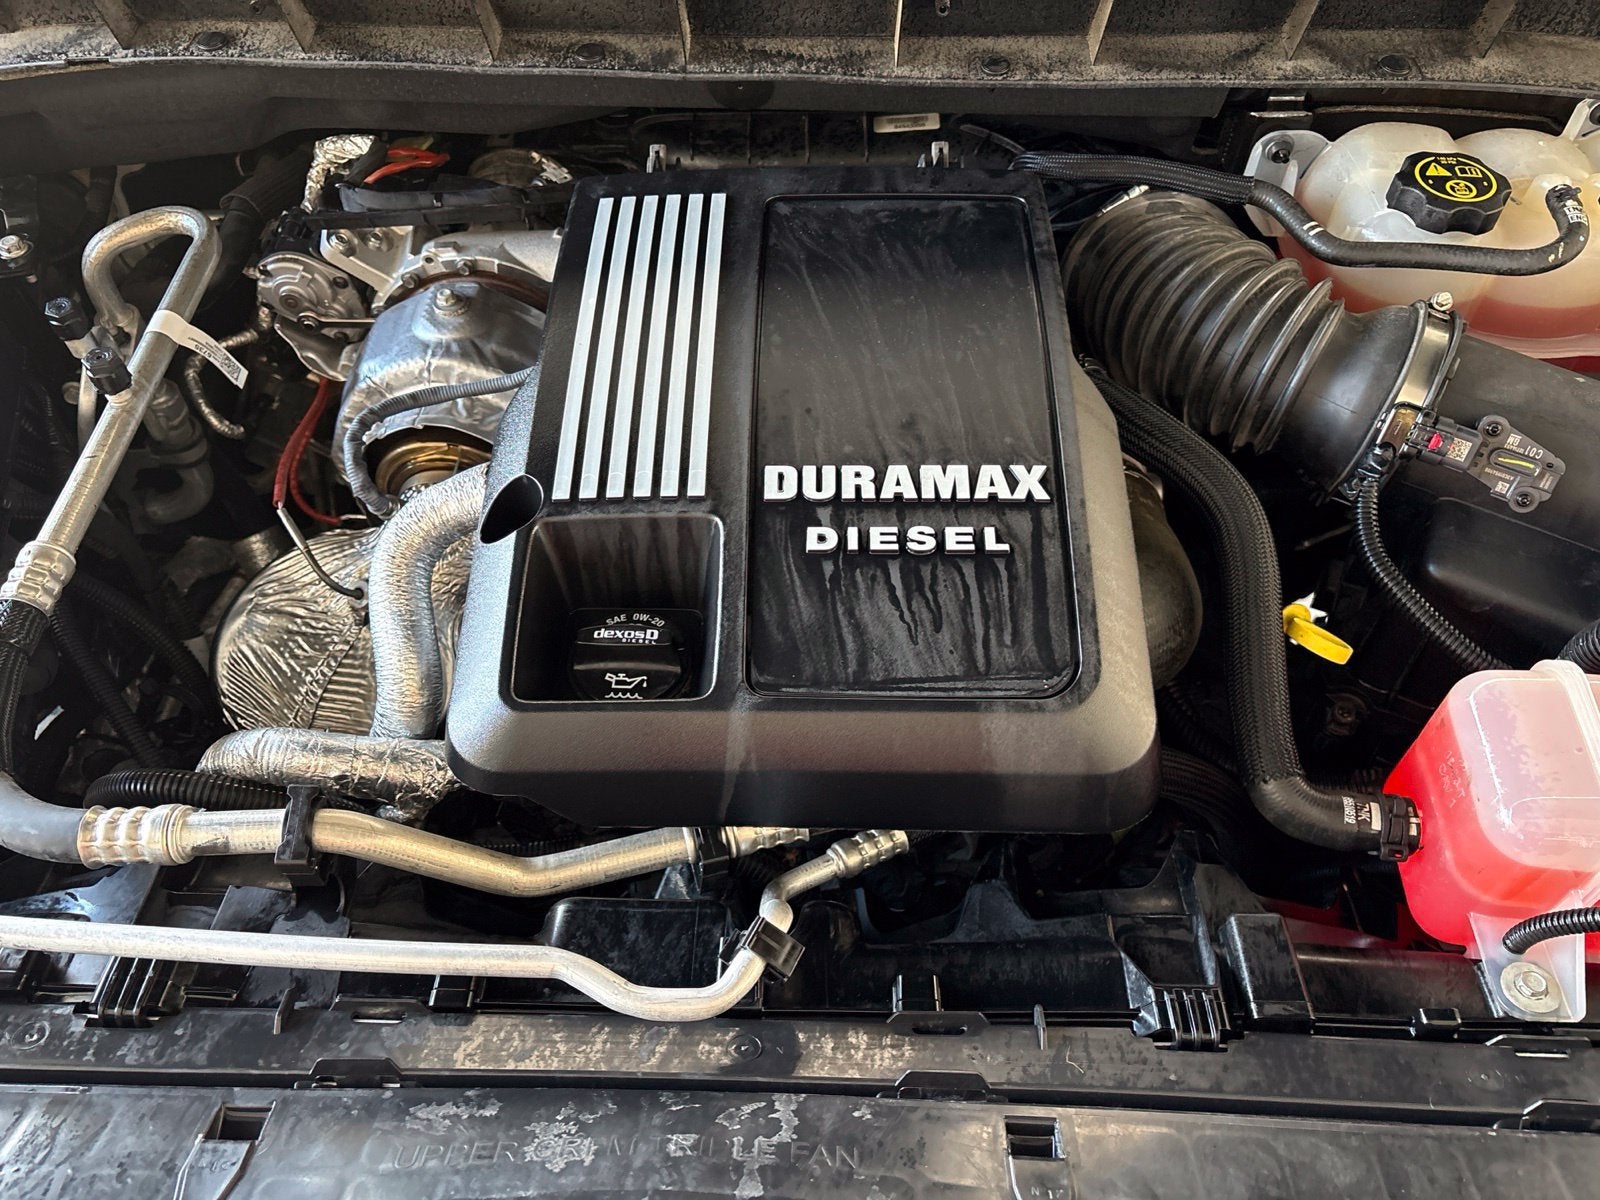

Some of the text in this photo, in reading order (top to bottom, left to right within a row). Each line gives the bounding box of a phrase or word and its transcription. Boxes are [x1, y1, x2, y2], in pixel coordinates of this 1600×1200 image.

[763, 464, 1051, 503] DURAMAX
[806, 525, 1011, 554] DIESEL
[606, 614, 627, 625] SAE
[393, 1139, 519, 1170] UPPER
[790, 1141, 860, 1169] FAN
